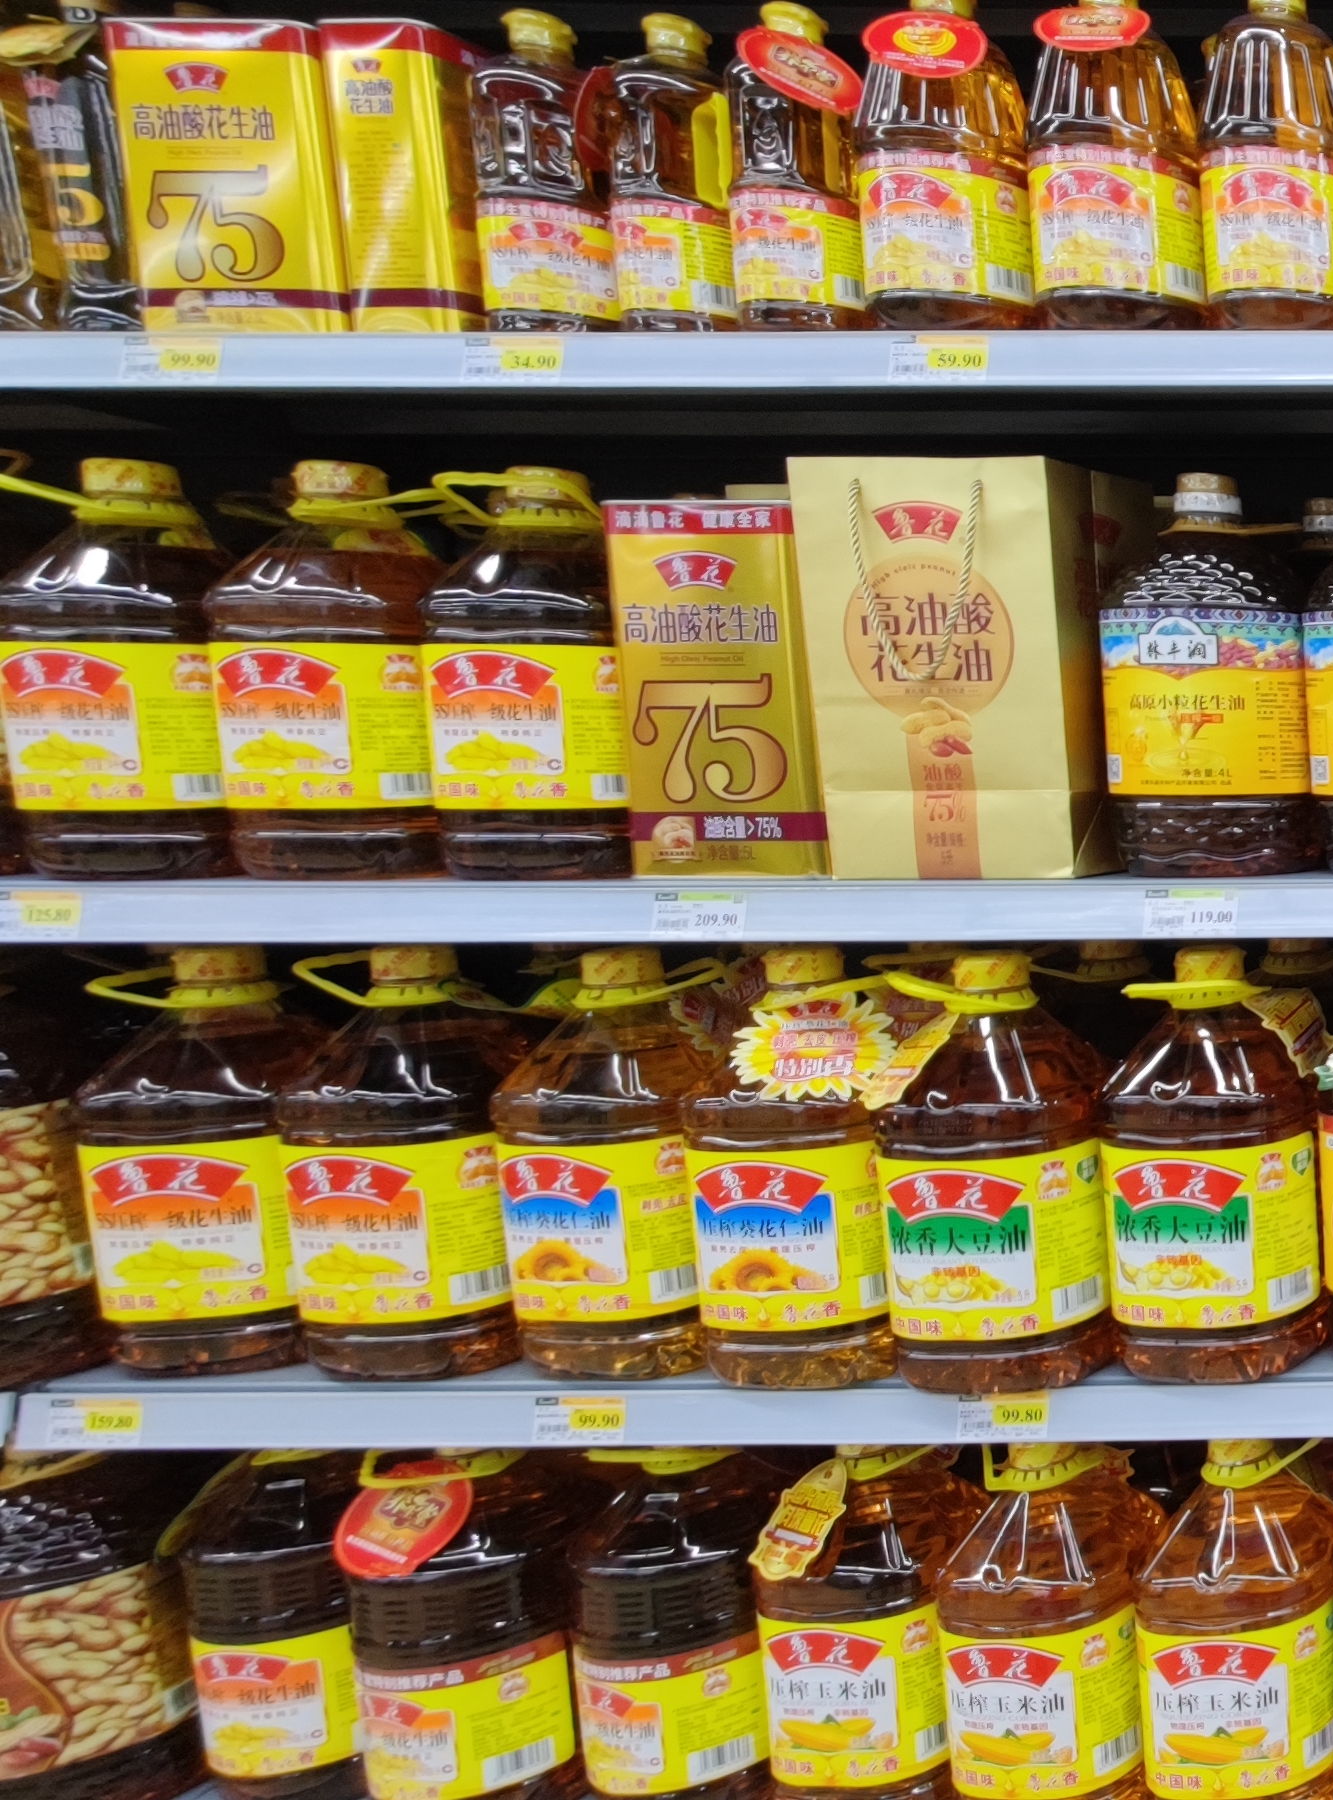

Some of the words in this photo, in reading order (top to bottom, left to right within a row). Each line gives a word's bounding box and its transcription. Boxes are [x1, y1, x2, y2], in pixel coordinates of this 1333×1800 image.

[131, 103, 276, 140] 高油酸花生油
[147, 164, 284, 283] 75
[171, 353, 217, 369] 99.90
[510, 353, 558, 370] 34.90
[937, 352, 982, 368] 59.90
[616, 510, 684, 528] 滴滴鲁花
[702, 511, 771, 528] 健康全家
[891, 509, 948, 537] 鲁花
[671, 558, 722, 583] 鲁花
[622, 603, 778, 643] 高油酸花生油
[857, 592, 996, 635] 高油酸
[454, 657, 521, 688] 鲁花
[867, 639, 993, 681] 花生油
[1129, 693, 1245, 711] 高原小粒花生油
[633, 673, 788, 804] 75
[924, 792, 966, 822] 75%
[695, 914, 738, 927] 209.90
[1190, 909, 1233, 924] 119.00
[118, 1161, 206, 1194] 鲁花
[307, 1164, 378, 1195] 鲁花
[513, 1160, 580, 1194] 鲁花
[720, 1168, 791, 1200] 鲁花
[1140, 1166, 1212, 1200] 鲁花
[912, 1177, 989, 1212] 鲁花
[892, 1221, 1027, 1257] 浓香大豆油
[1117, 1211, 1246, 1244] 浓香大豆油
[579, 1414, 619, 1428] 99.90
[1002, 1409, 1043, 1423] 99.80
[788, 1634, 853, 1665] 鲁花
[966, 1649, 1032, 1680] 鲁花
[1179, 1647, 1247, 1678] 鲁花
[770, 1676, 886, 1701] 压榨玉米油
[951, 1688, 1065, 1715] 压榨玉米油
[1155, 1687, 1279, 1715] 压榨玉米油
